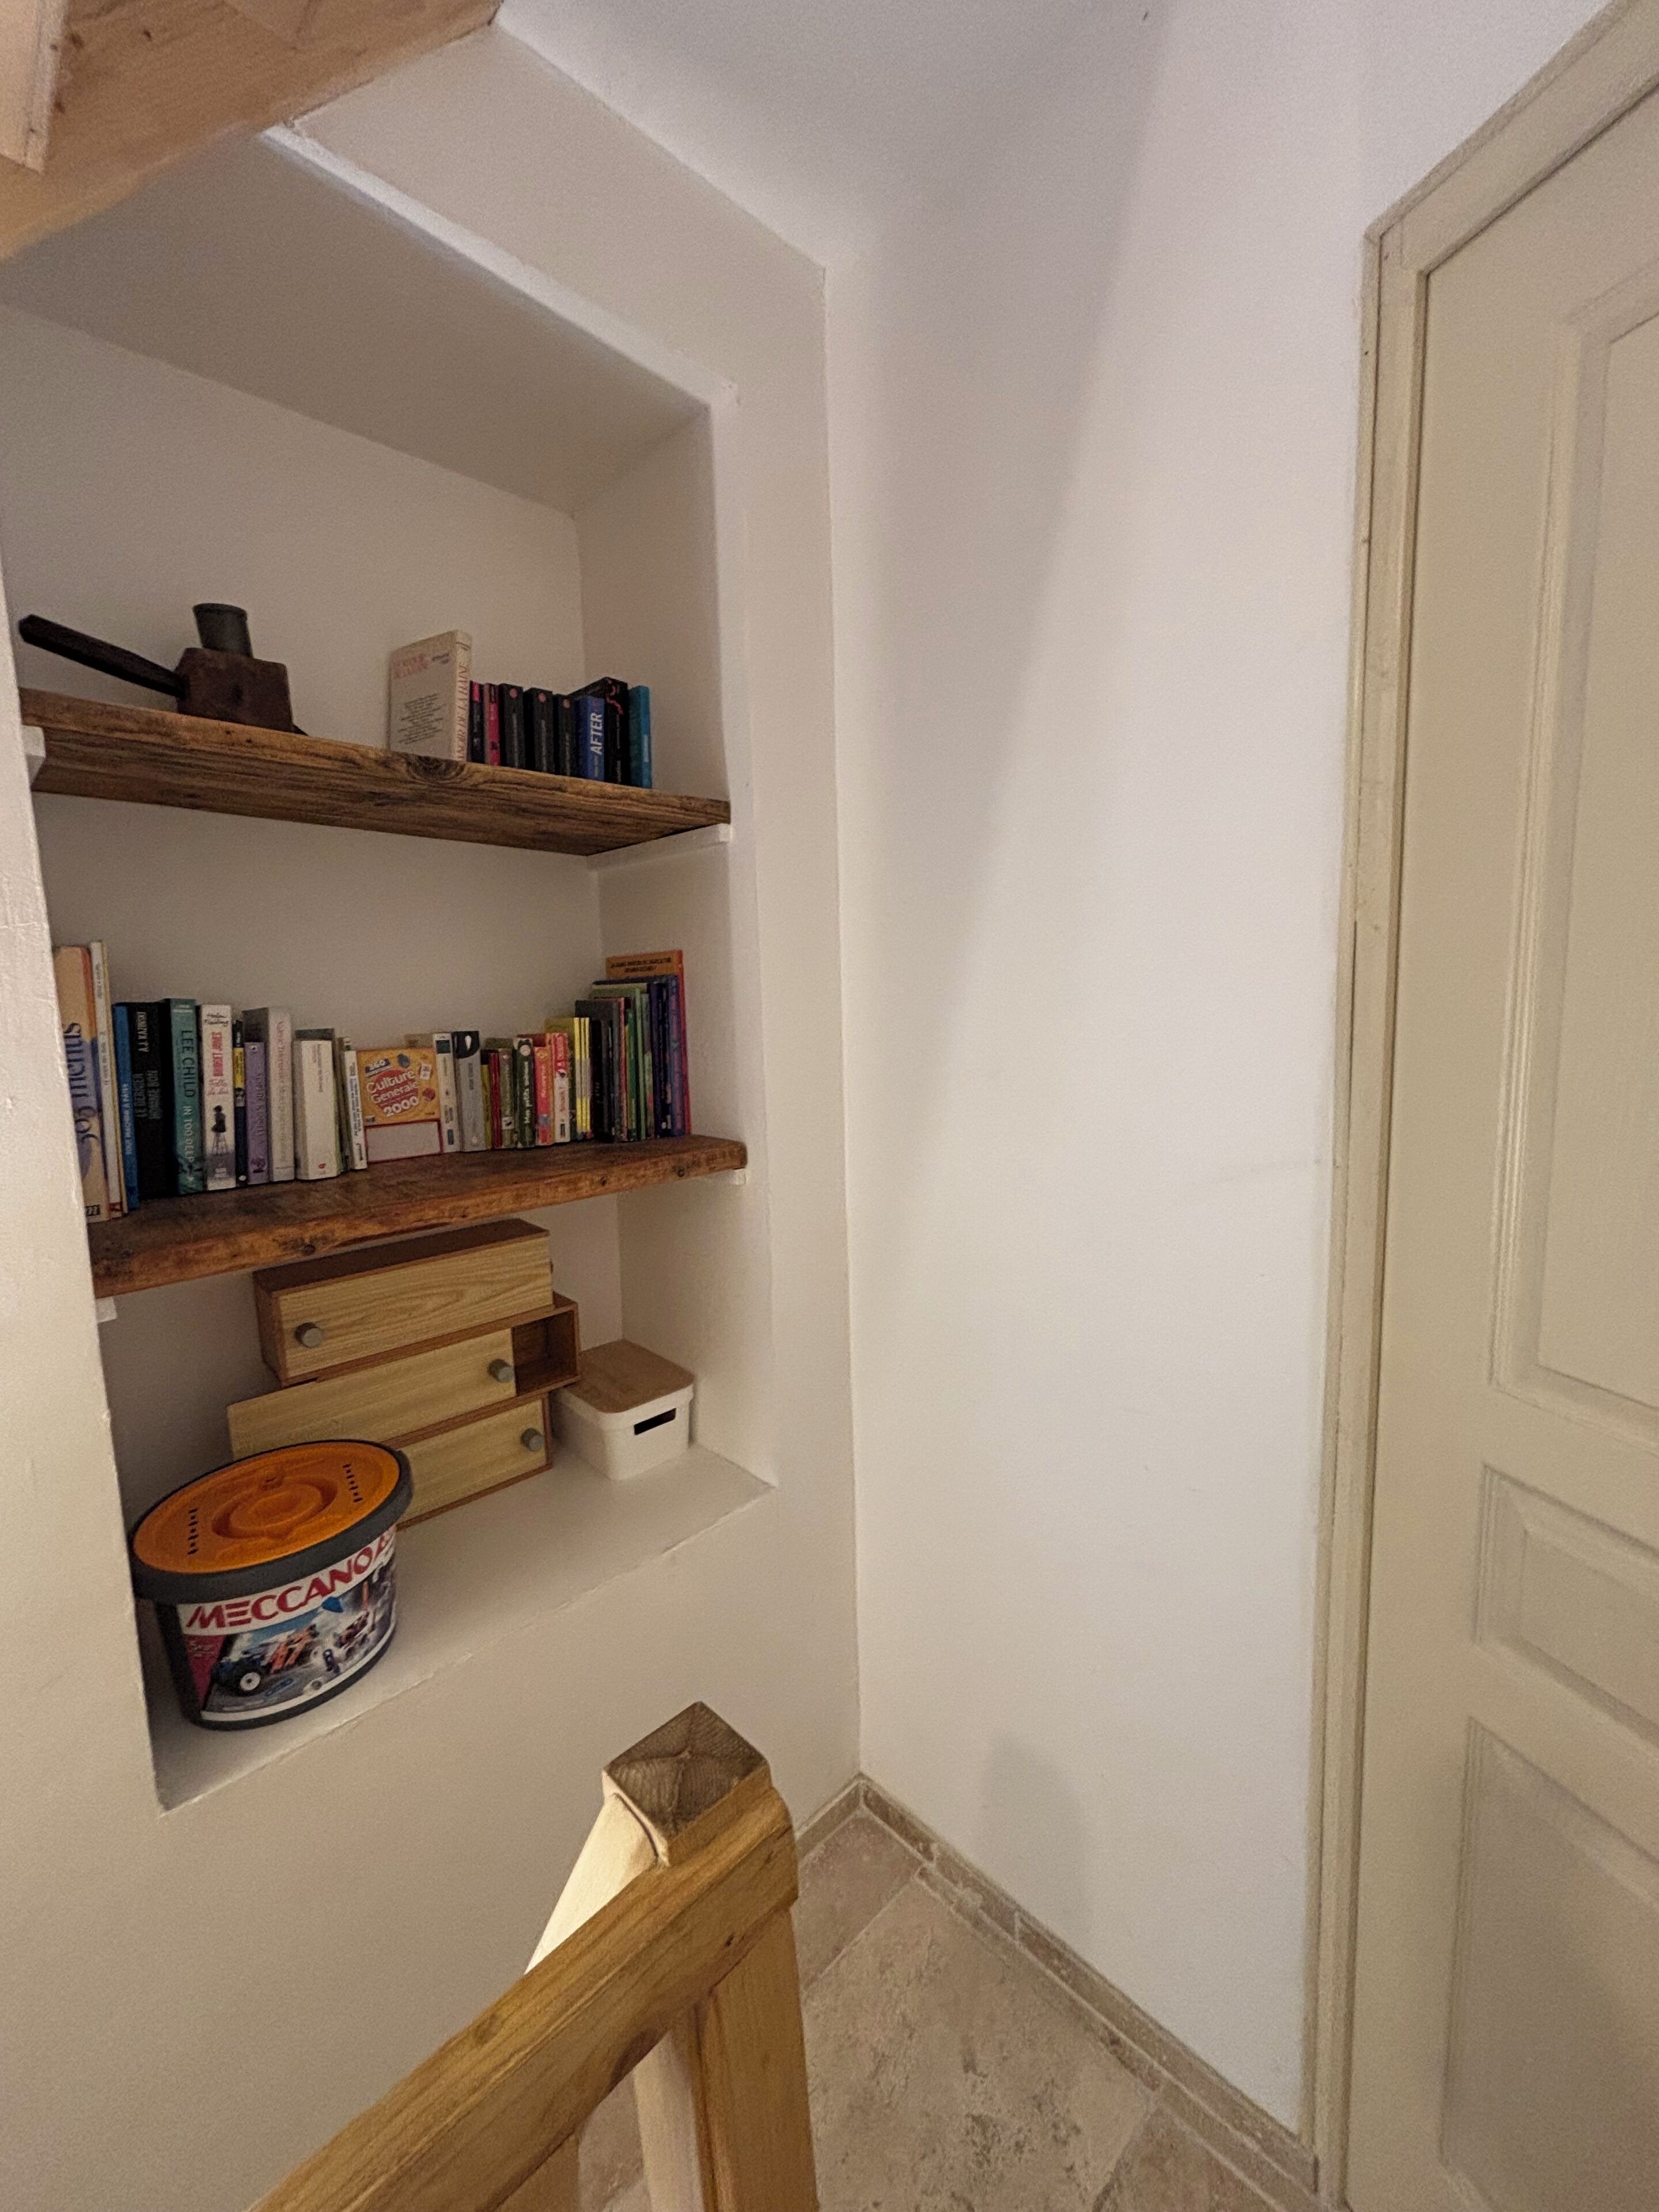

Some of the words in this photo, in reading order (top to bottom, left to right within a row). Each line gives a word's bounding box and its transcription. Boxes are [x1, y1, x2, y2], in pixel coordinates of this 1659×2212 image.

[589, 712, 603, 755] AFTER
[180, 1029, 194, 1054] LEE
[132, 1073, 146, 1107] DERNIER
[182, 1057, 196, 1099] CHILD
[366, 1069, 416, 1094] Culture
[182, 1105, 193, 1116] IN
[383, 1096, 419, 1118] 2000
[182, 1118, 194, 1137] TOO
[183, 1138, 196, 1162] DEEP
[186, 1546, 373, 1630] MECCANO
